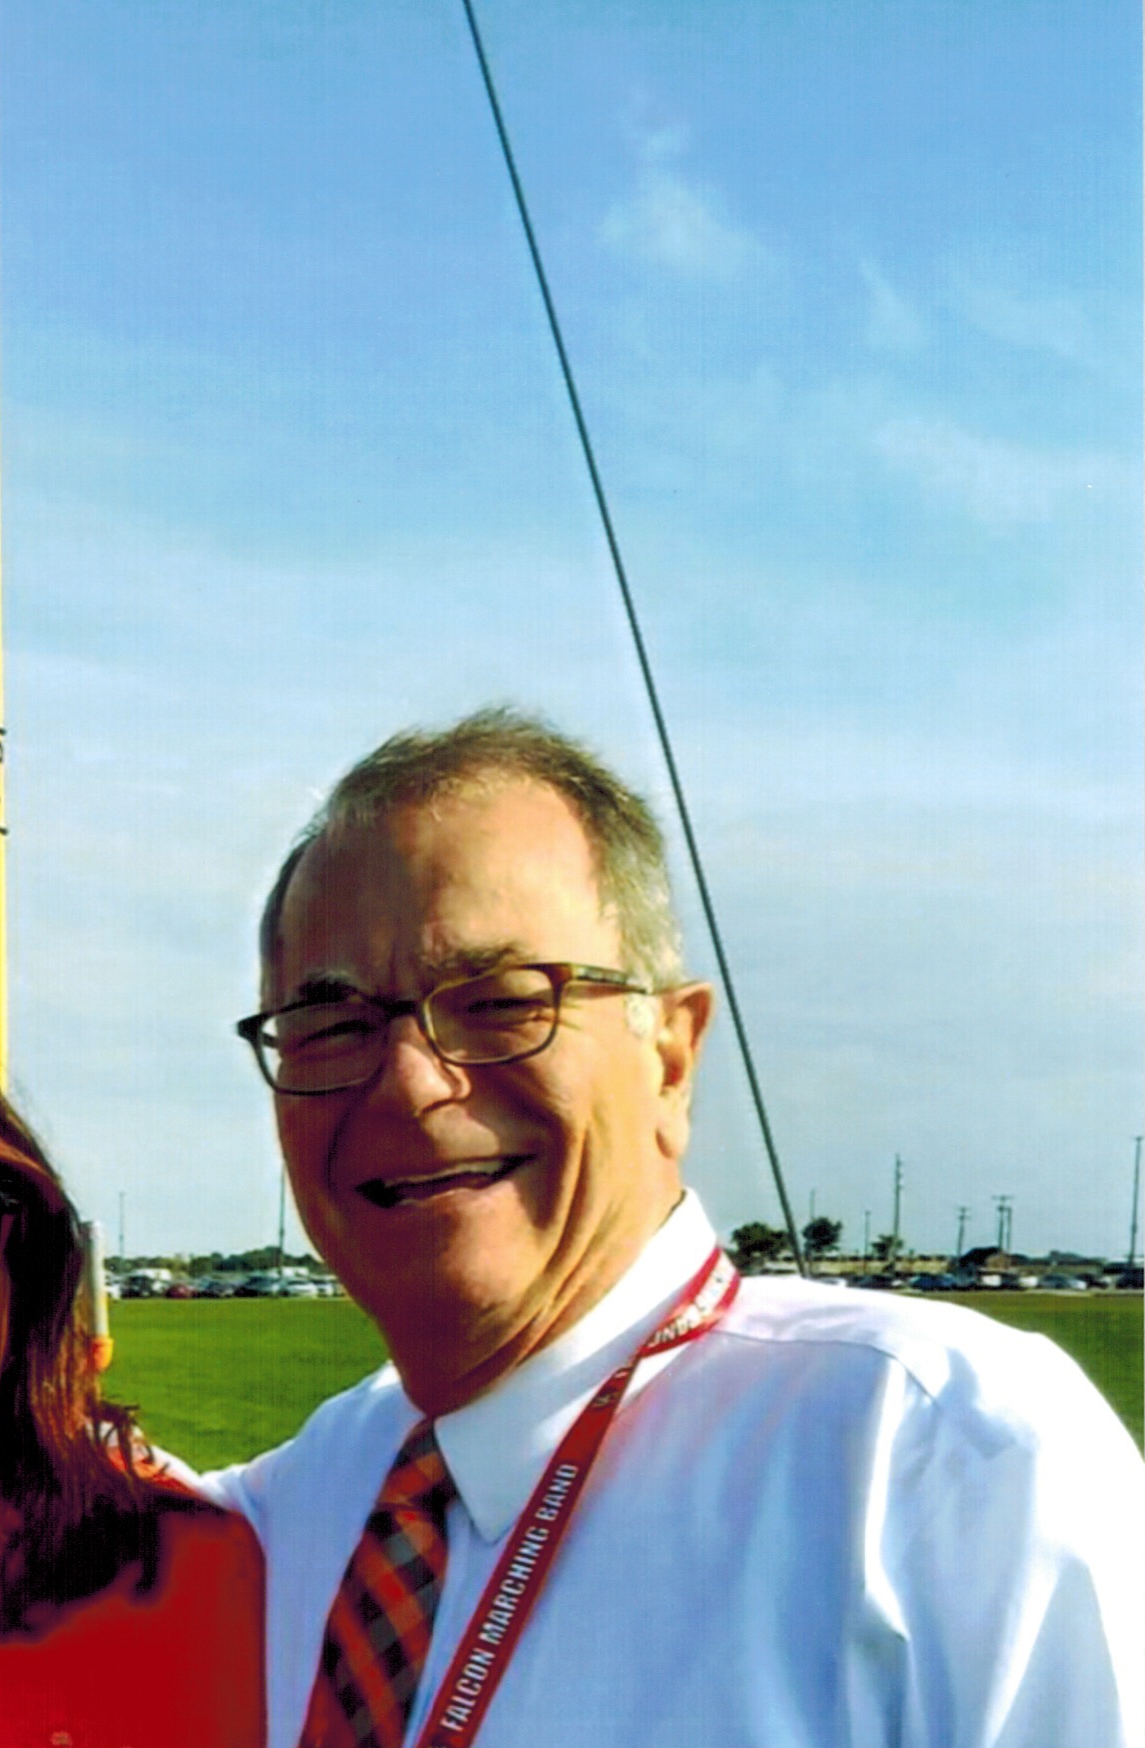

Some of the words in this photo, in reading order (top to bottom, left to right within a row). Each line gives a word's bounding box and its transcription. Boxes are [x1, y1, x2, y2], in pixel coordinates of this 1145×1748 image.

[440, 1648, 496, 1732] FALCON
[479, 1525, 550, 1644] MARCHING
[535, 1463, 578, 1521] BAND
